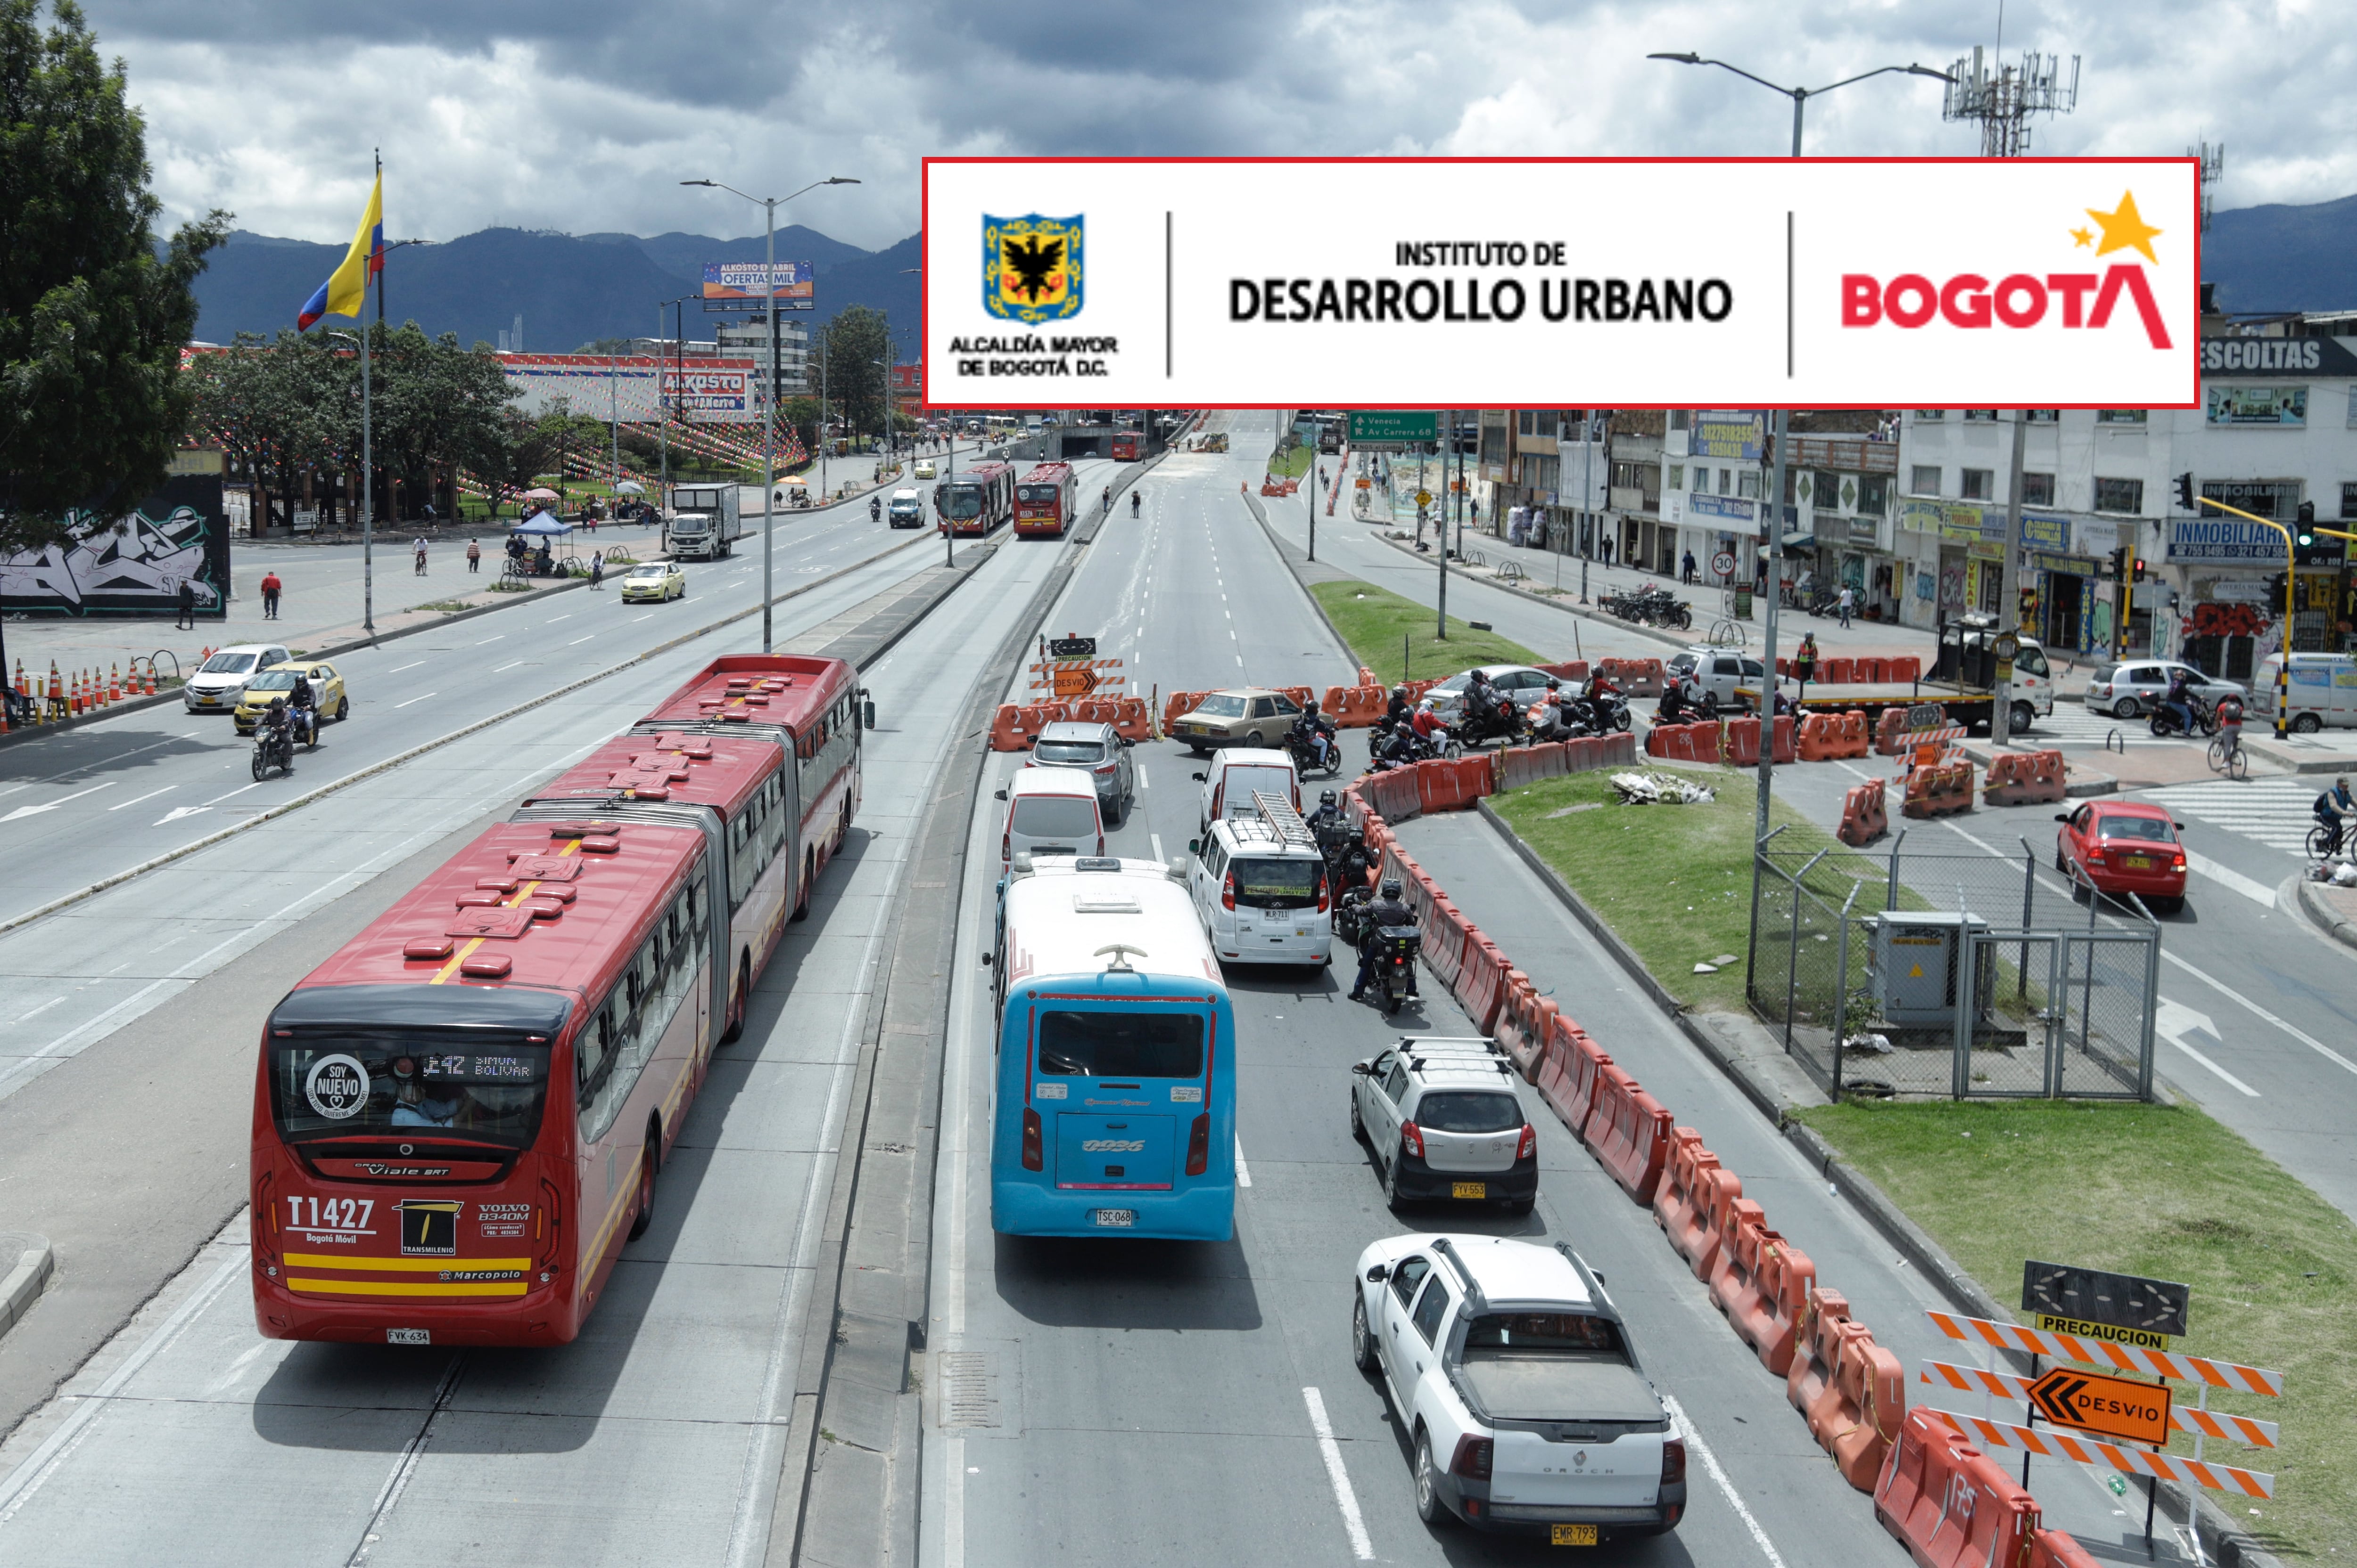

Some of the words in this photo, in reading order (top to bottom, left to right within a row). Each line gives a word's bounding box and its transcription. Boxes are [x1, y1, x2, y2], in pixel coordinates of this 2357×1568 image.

[721, 264, 756, 272] ALKOSTO
[724, 273, 767, 284] OFERTAS
[774, 273, 792, 283] MIL
[664, 375, 742, 391] ALKOSTO
[2205, 484, 2298, 497] INMOBILIARIA
[2035, 530, 2062, 542] TORNILLOS
[2176, 523, 2294, 544] INMOBILIARIA
[2188, 547, 2203, 556] 755
[2205, 547, 2225, 557] 9495
[2237, 547, 2253, 557] 321
[2256, 547, 2271, 557] 457
[2272, 547, 2288, 558] 584
[1716, 558, 1732, 569] 30
[2042, 556, 2064, 571] TORNILLOS
[2327, 557, 2341, 565] 202
[2081, 586, 2091, 651] TORNILLOS
[1056, 678, 1084, 687] DESVIO
[329, 1066, 346, 1078] SOY
[475, 1066, 529, 1076] BOLIVAR
[317, 1078, 358, 1095] NUEVO
[1454, 1184, 1484, 1194] FYV-553
[288, 1196, 375, 1228] T1427
[478, 1213, 529, 1221] B340M
[1098, 1211, 1131, 1221] TSC-068
[306, 1233, 333, 1244] Bogotá
[335, 1234, 356, 1243] Móvil
[453, 1271, 520, 1280] Marcopolo
[388, 1331, 428, 1341] FVK-634
[2044, 1317, 2162, 1348] PRECAUCION
[2078, 1394, 2159, 1422] DESVIO
[1553, 1526, 1595, 1540] EMR-793
